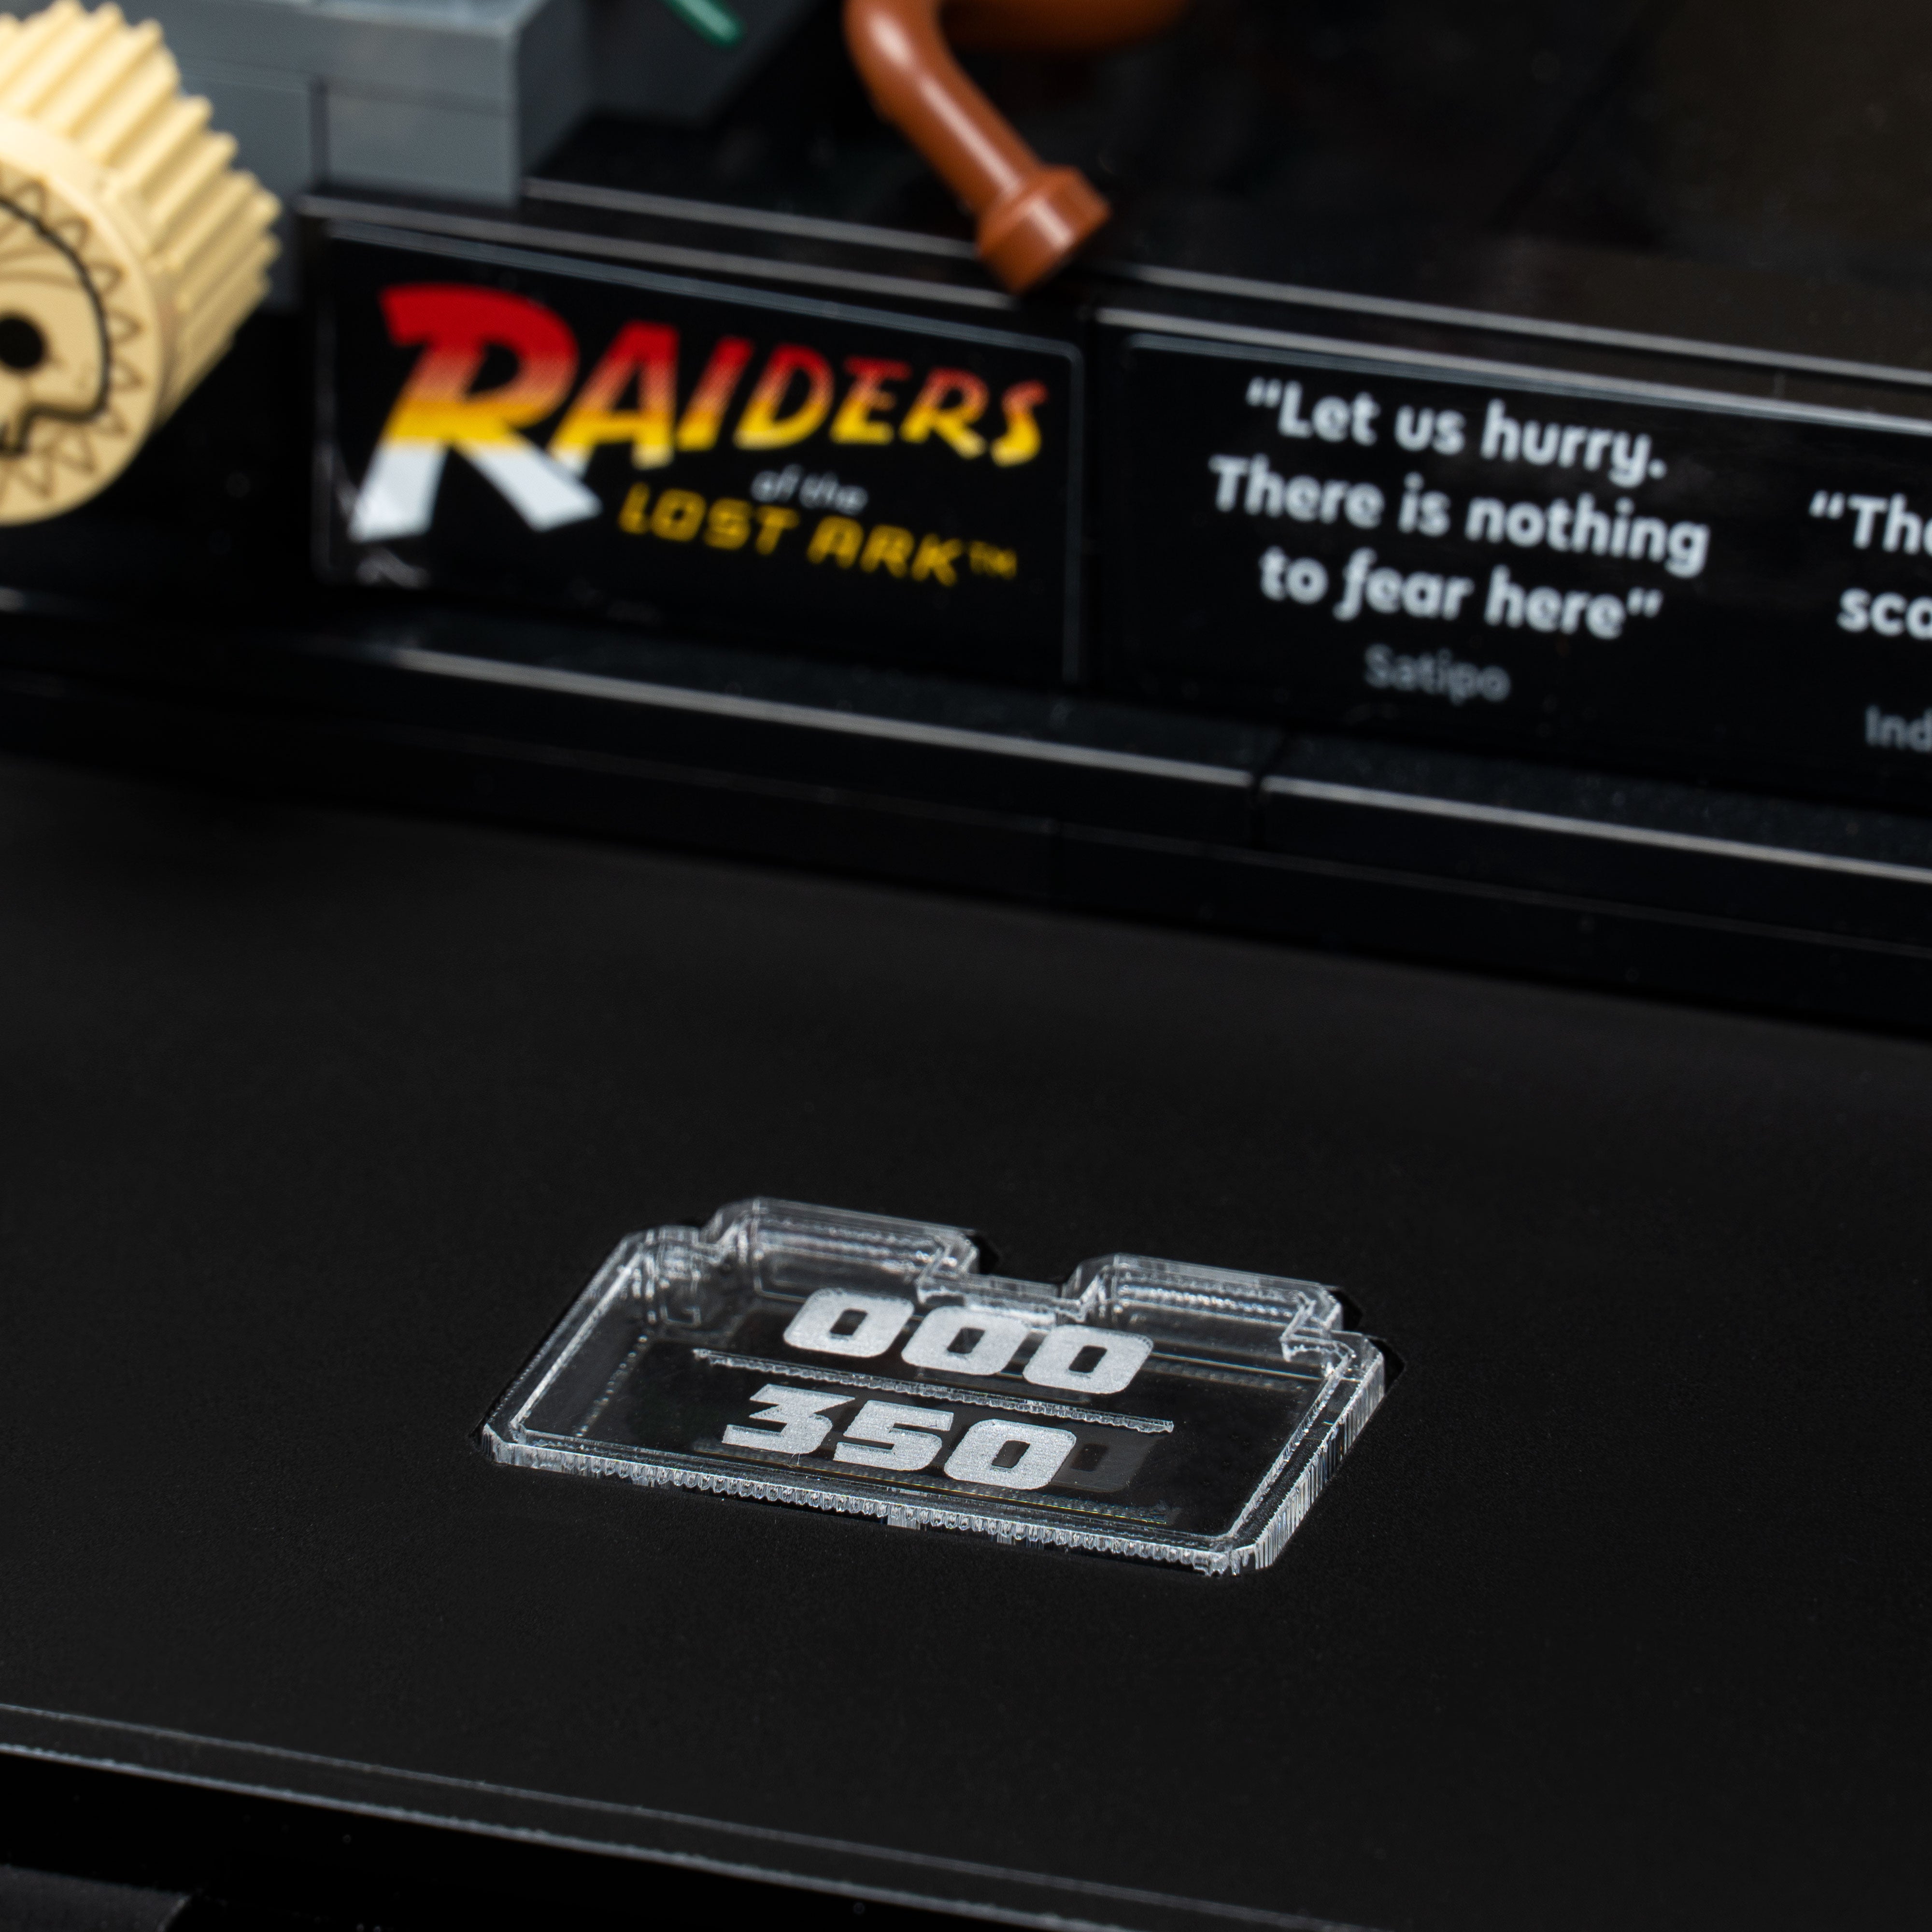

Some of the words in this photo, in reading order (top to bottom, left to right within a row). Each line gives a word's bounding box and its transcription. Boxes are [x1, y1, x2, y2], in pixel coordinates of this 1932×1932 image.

[348, 283, 1048, 542] RAIDERS
[1394, 405, 1465, 455] us
[1480, 398, 1667, 488] hurry.
[618, 482, 801, 556] LOST
[751, 464, 802, 502] of
[798, 471, 869, 516] the
[1208, 453, 1385, 529] There
[1398, 471, 1450, 538] is
[1464, 493, 1710, 578] nothing
[1808, 490, 1932, 555] "Th
[1260, 545, 1328, 605] to
[1333, 548, 1473, 622] fear
[1363, 644, 1512, 707] Satipo
[783, 1288, 1153, 1394] 000
[722, 1383, 1077, 1490] 350
